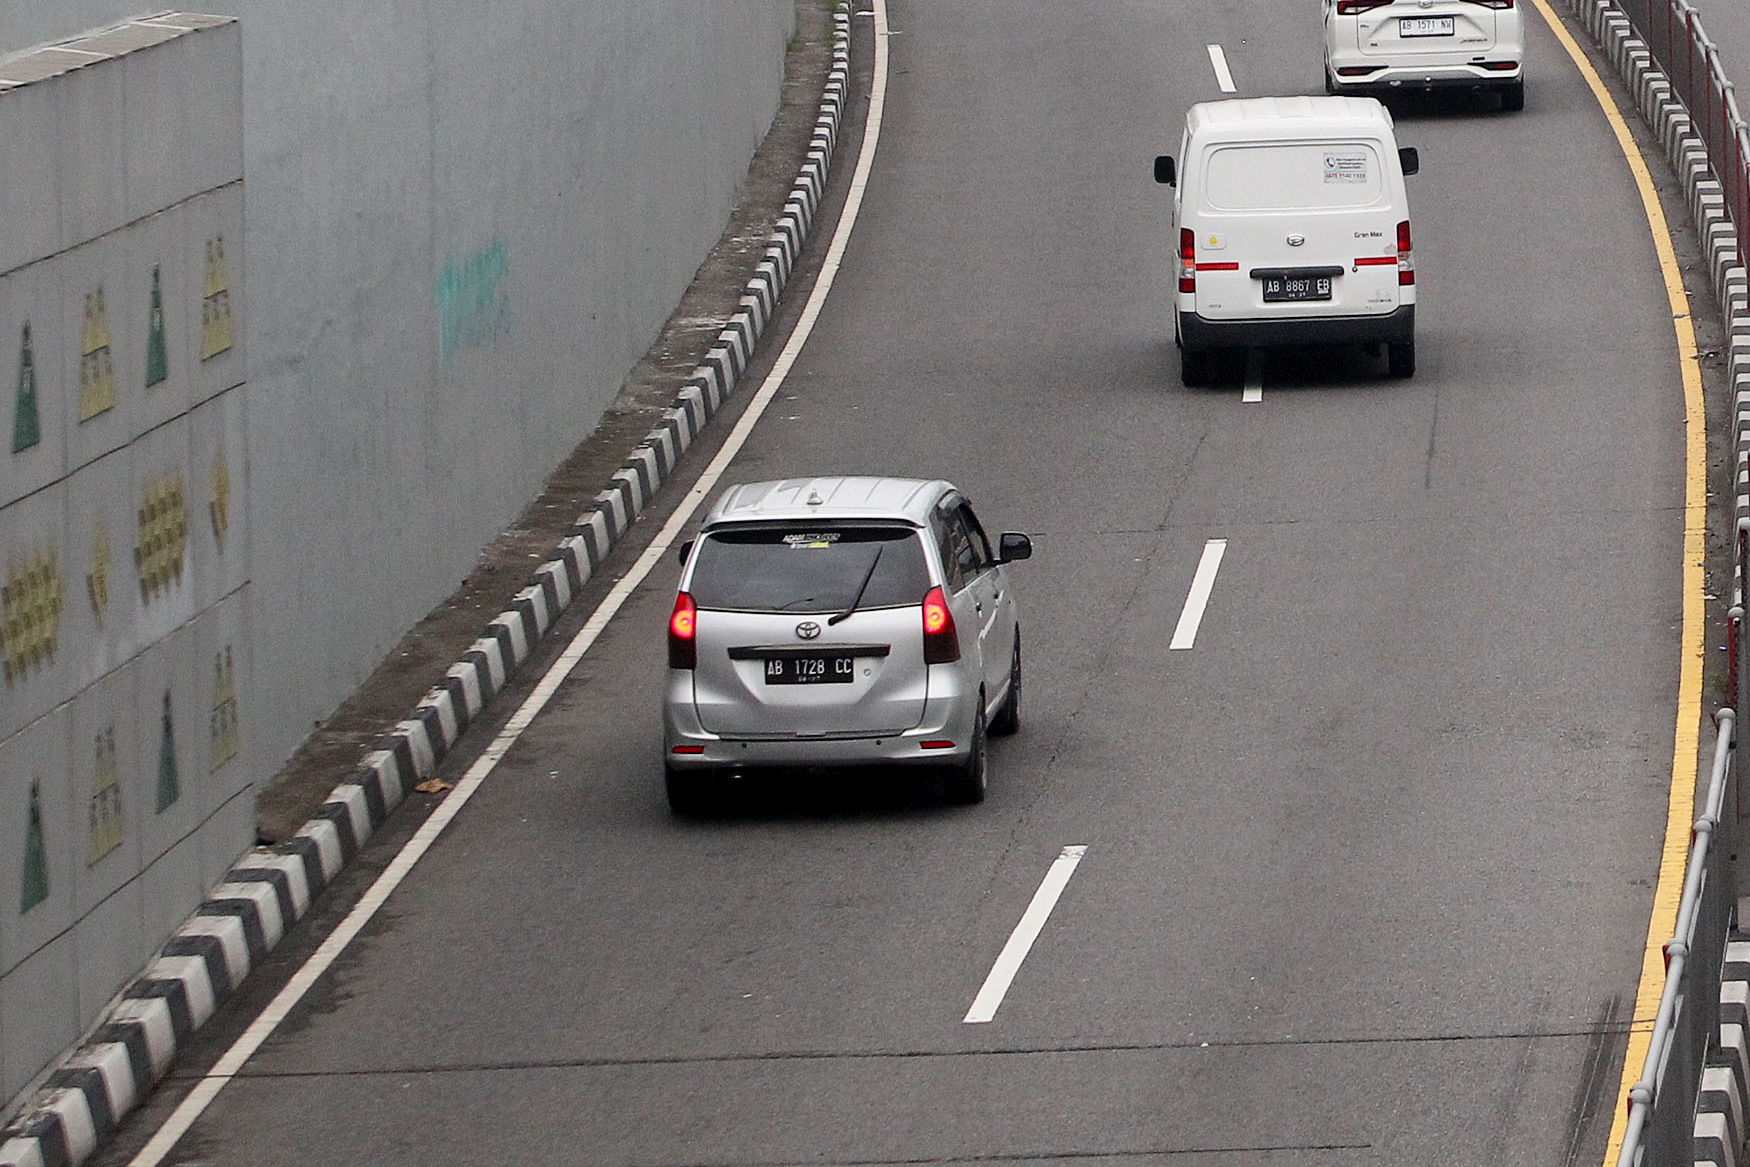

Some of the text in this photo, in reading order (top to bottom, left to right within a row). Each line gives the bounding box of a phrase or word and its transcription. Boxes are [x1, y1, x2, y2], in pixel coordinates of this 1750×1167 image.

[1402, 20, 1412, 30] AB
[1417, 19, 1435, 30] 1571
[1266, 280, 1280, 294] AB
[1286, 279, 1310, 292] 8867
[767, 658, 852, 675] AB 1728 CC
